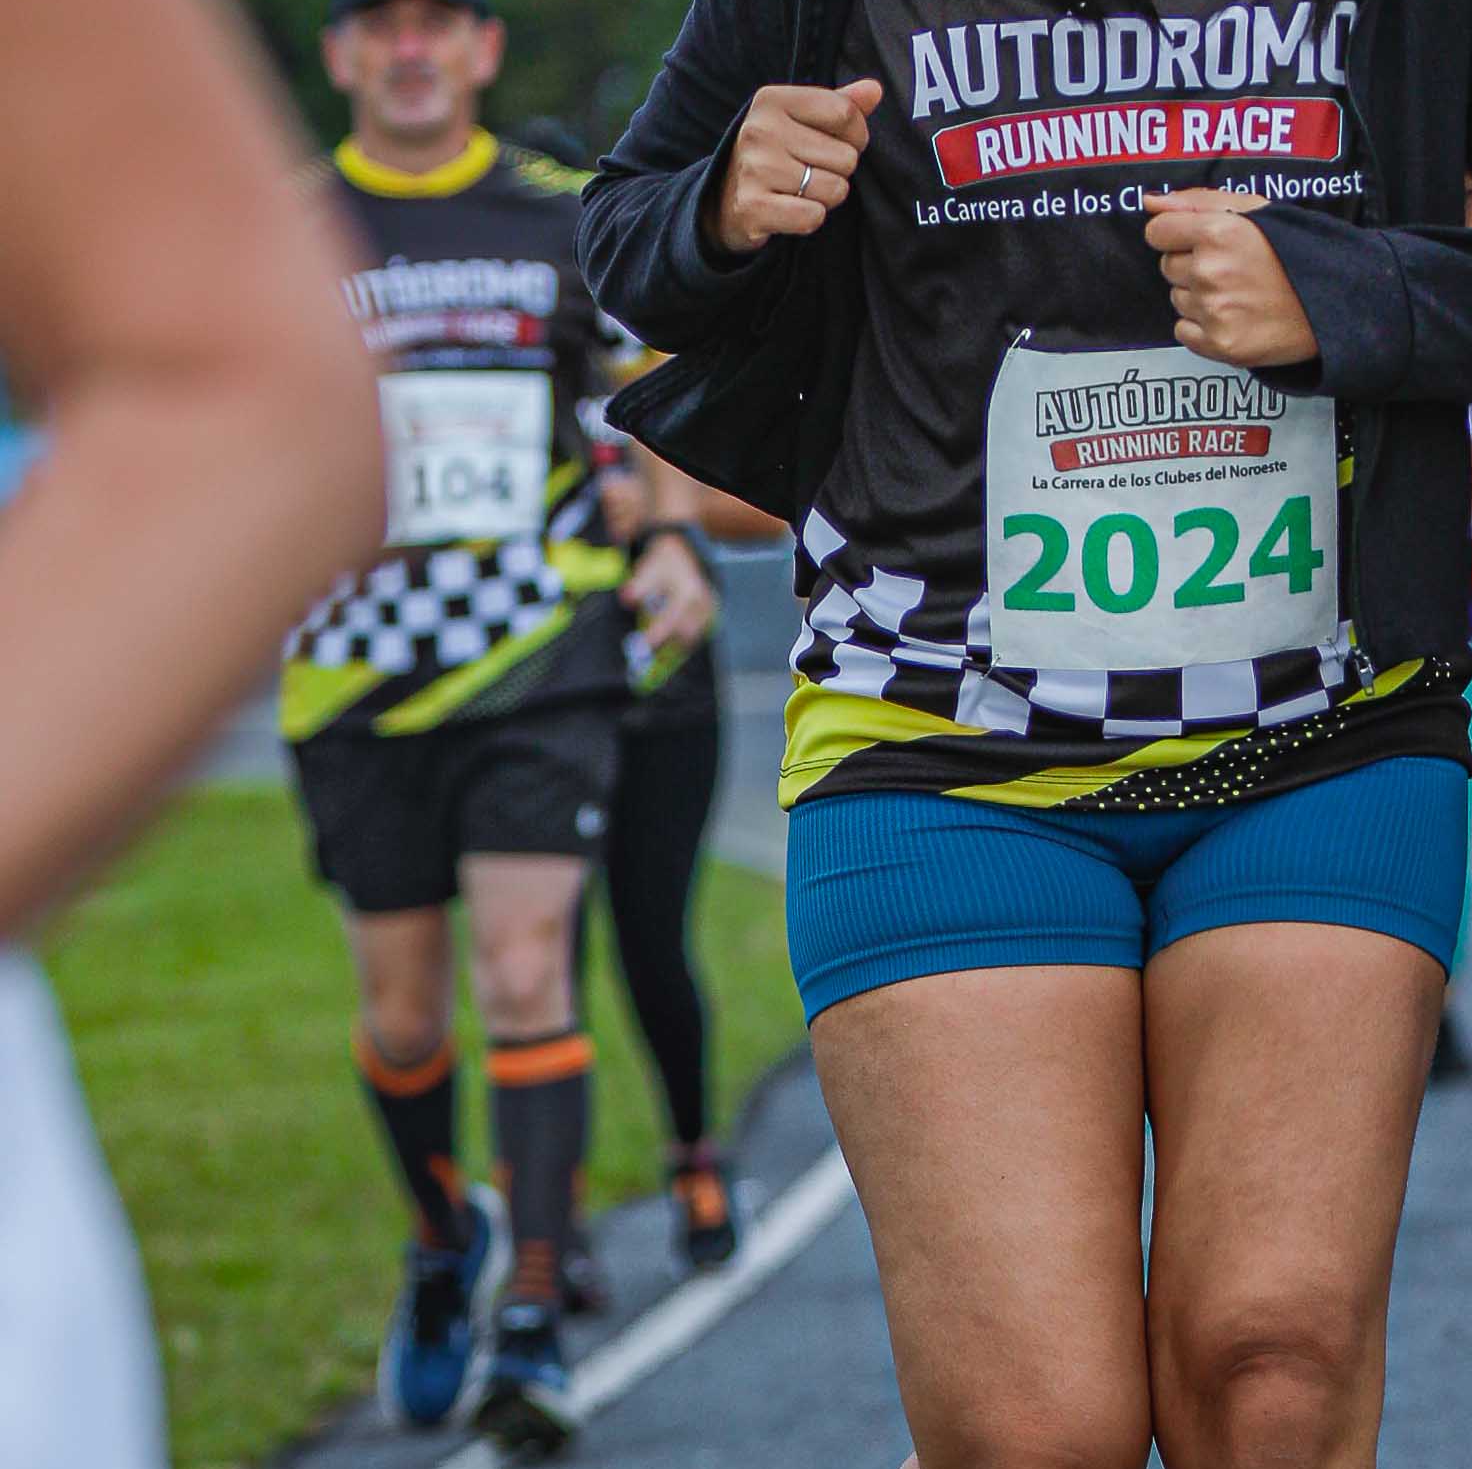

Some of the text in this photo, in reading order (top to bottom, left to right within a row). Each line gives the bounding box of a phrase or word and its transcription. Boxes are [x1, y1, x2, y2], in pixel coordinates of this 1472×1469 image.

[976, 106, 1295, 175] RUNNING RACE
[915, 200, 940, 225] La
[944, 197, 1025, 222] Carrera
[1033, 189, 1066, 217] de
[1074, 188, 1112, 215] los
[1264, 170, 1363, 200] Noroest
[1032, 460, 1288, 490] La Carrera de los Clubes del Noroeste
[1076, 429, 1247, 466] RUNNING RACE
[1003, 495, 1325, 614] 2024
